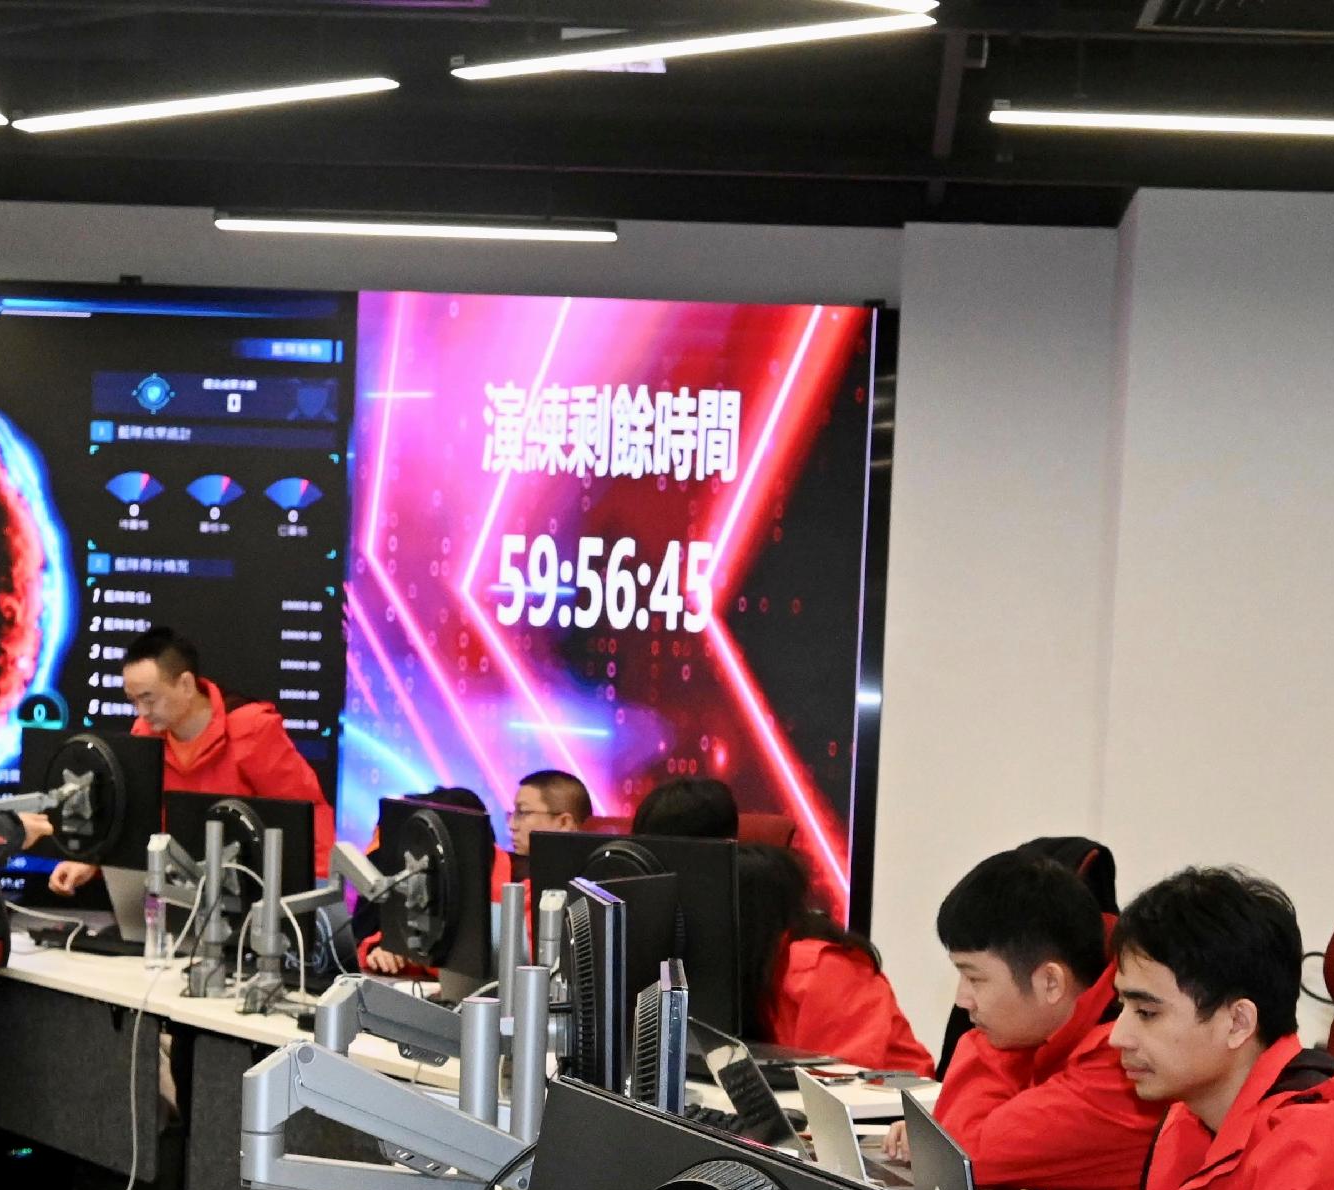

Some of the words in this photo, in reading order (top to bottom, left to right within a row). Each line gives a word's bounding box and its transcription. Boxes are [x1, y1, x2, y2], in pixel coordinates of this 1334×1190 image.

[227, 393, 241, 412] 0
[482, 380, 741, 482] 演練剩餘時間
[496, 534, 713, 632] 59:56:45
[89, 616, 101, 631] 2
[89, 643, 101, 660] 3
[88, 672, 99, 687] 4
[33, 704, 46, 723] 0
